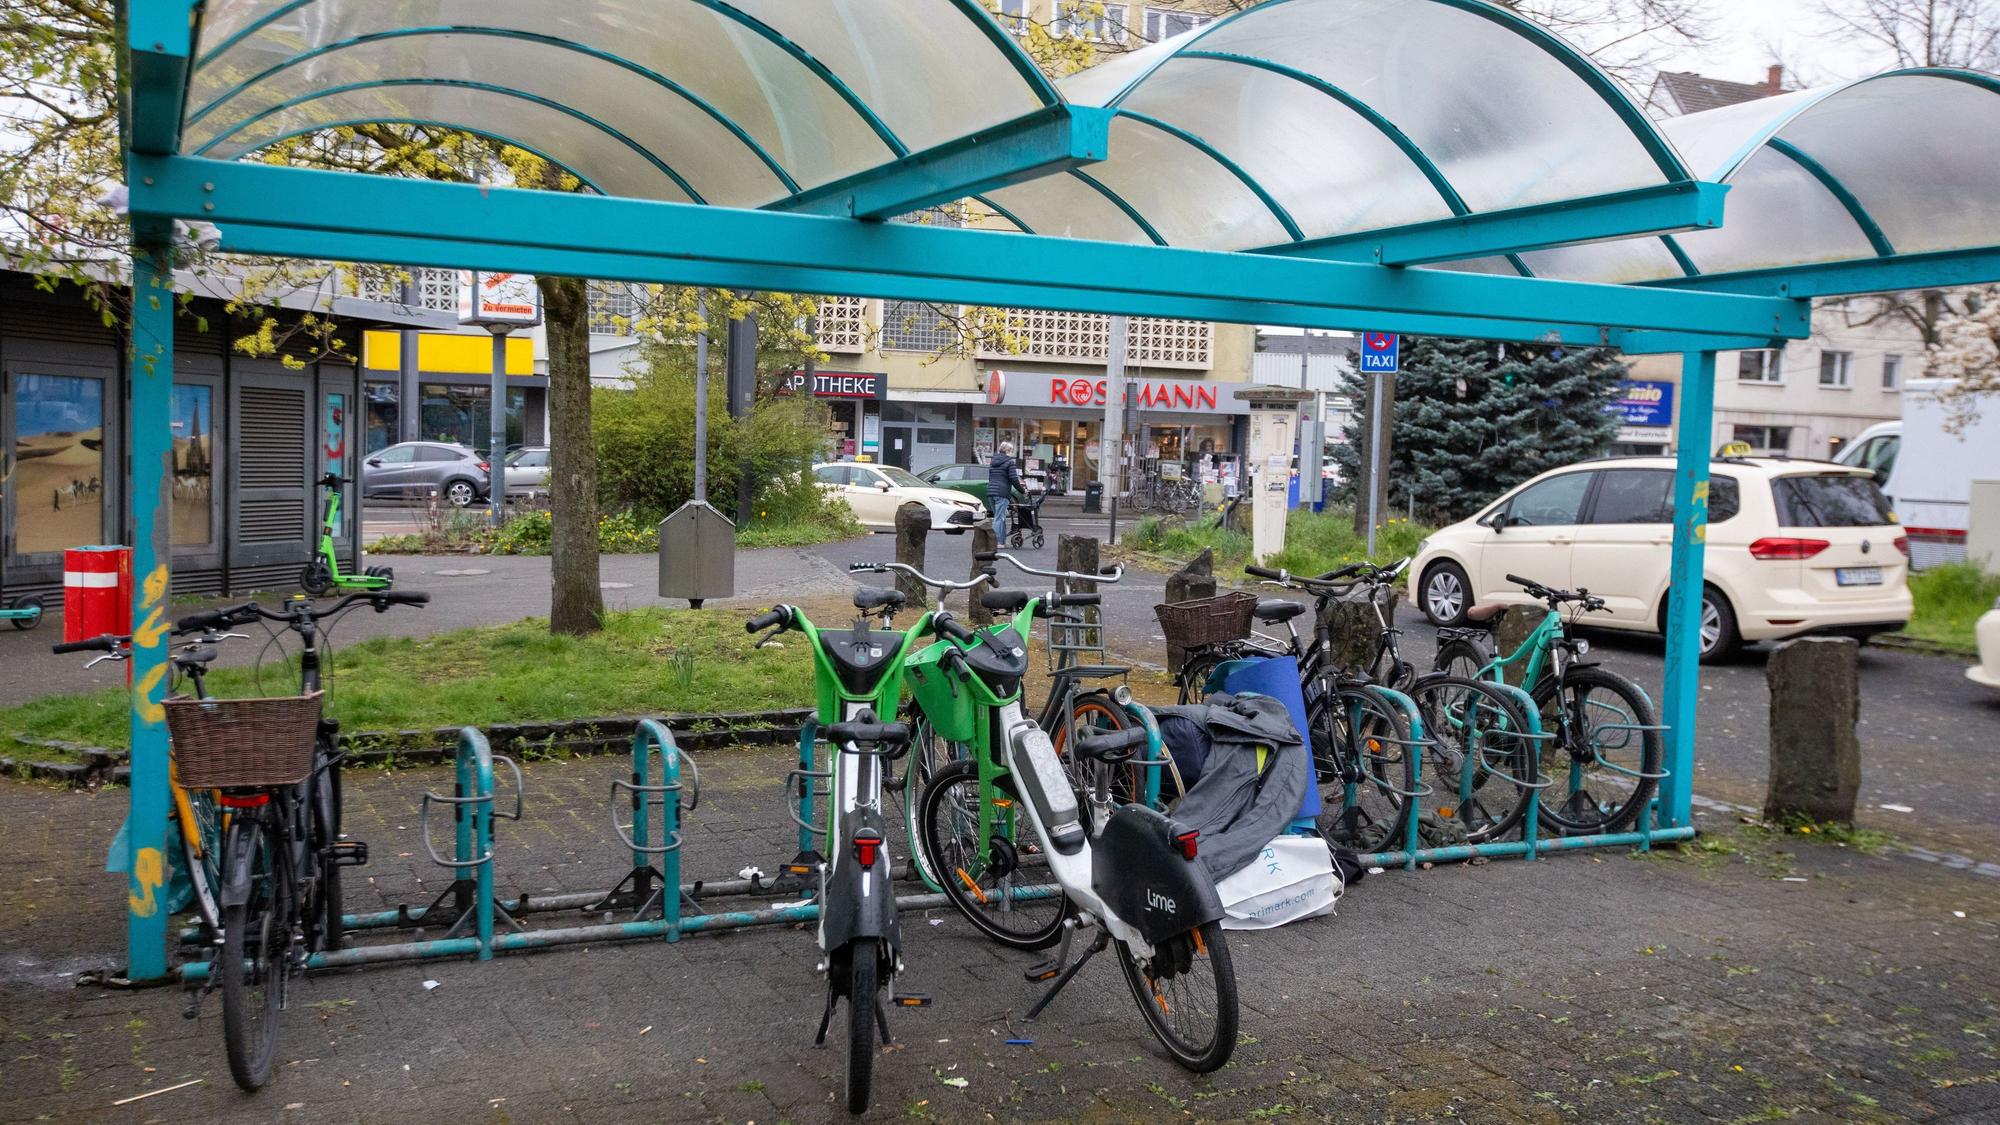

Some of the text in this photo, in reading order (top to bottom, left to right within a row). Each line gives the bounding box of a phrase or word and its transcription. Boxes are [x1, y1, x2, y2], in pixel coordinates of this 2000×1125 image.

[1364, 355, 1394, 368] TAXI
[1050, 378, 1217, 409] ROSMANN
[1144, 888, 1177, 914] Lime
[1248, 887, 1316, 921] primark.com
